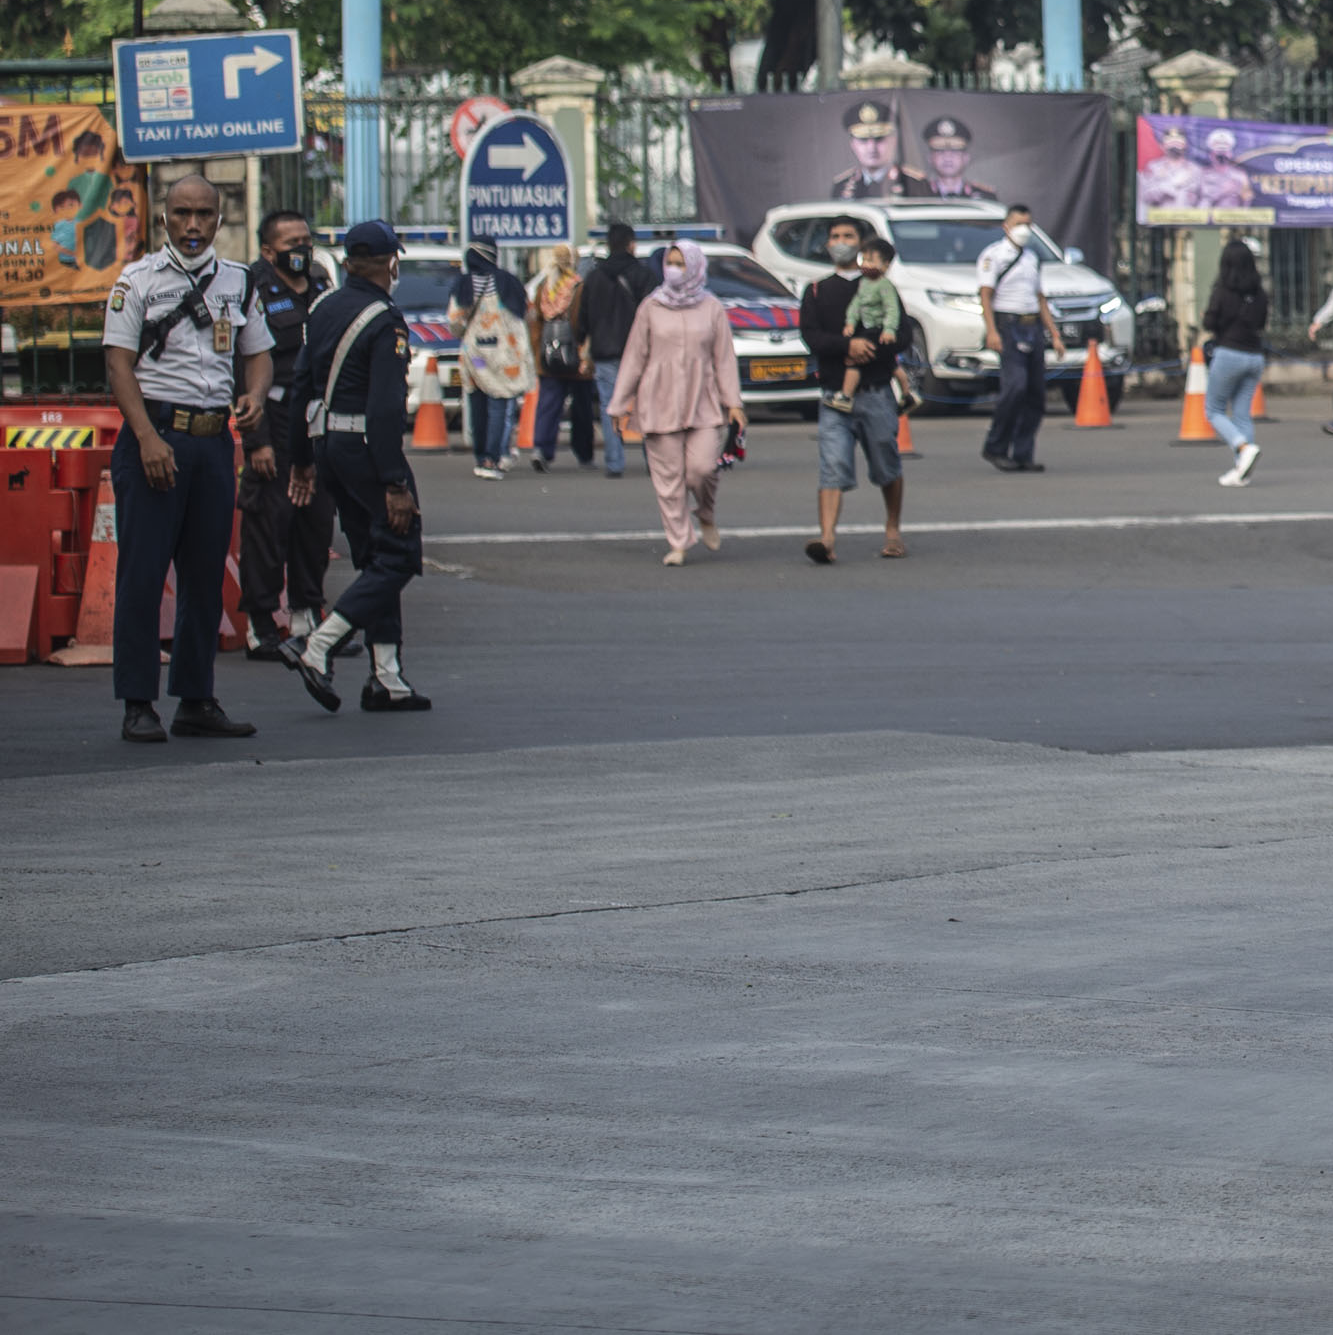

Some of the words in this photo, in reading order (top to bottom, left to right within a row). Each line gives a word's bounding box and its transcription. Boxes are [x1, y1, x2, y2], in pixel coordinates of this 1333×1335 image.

[143, 70, 184, 85] Grab
[136, 126, 171, 143] TAXI
[183, 123, 219, 140] TAXI
[222, 119, 285, 137] ONLINE
[468, 185, 510, 208] PINTU
[511, 185, 566, 208] MASUK
[472, 214, 521, 237] UTARA
